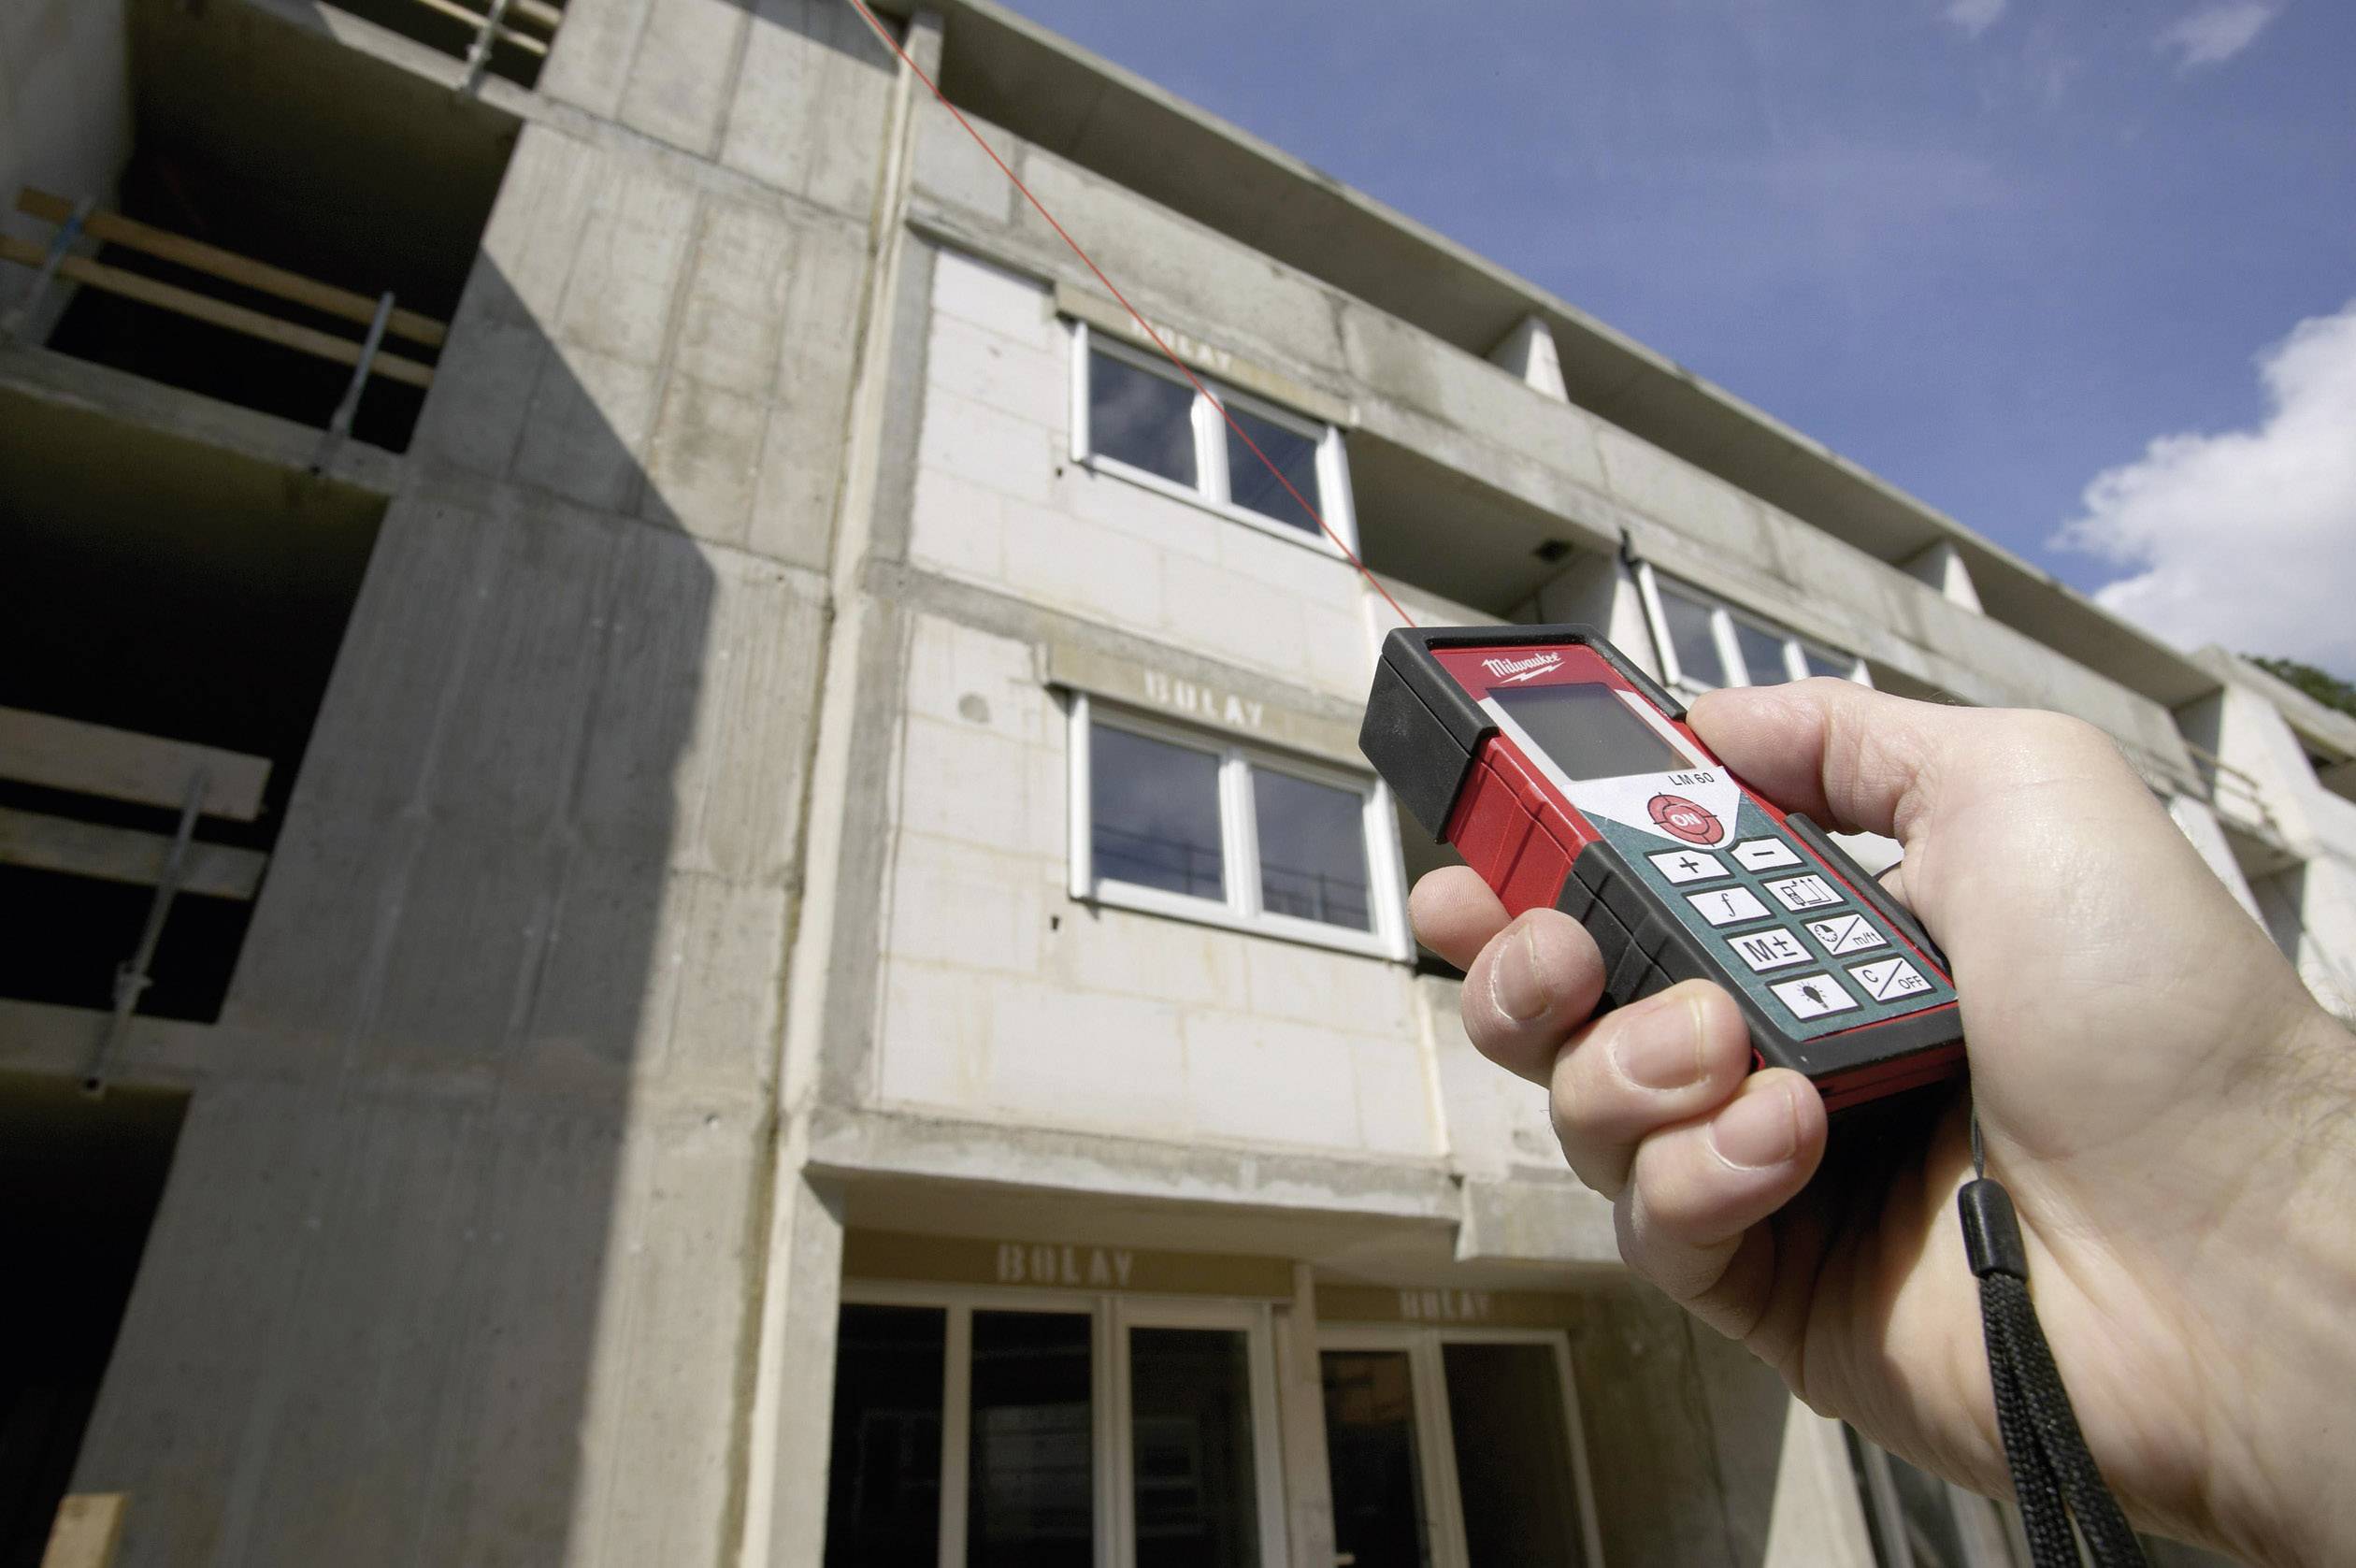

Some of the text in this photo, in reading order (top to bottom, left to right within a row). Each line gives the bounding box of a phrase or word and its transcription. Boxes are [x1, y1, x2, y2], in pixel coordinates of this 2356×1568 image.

[1481, 652, 1561, 678] Milwaukee
[1668, 772, 1715, 785] LM 60
[1671, 813, 1702, 827] ON
[1853, 931, 1880, 945] m/ft
[1862, 970, 1922, 989] C OFF
[998, 1244, 1133, 1287] BOLAY
